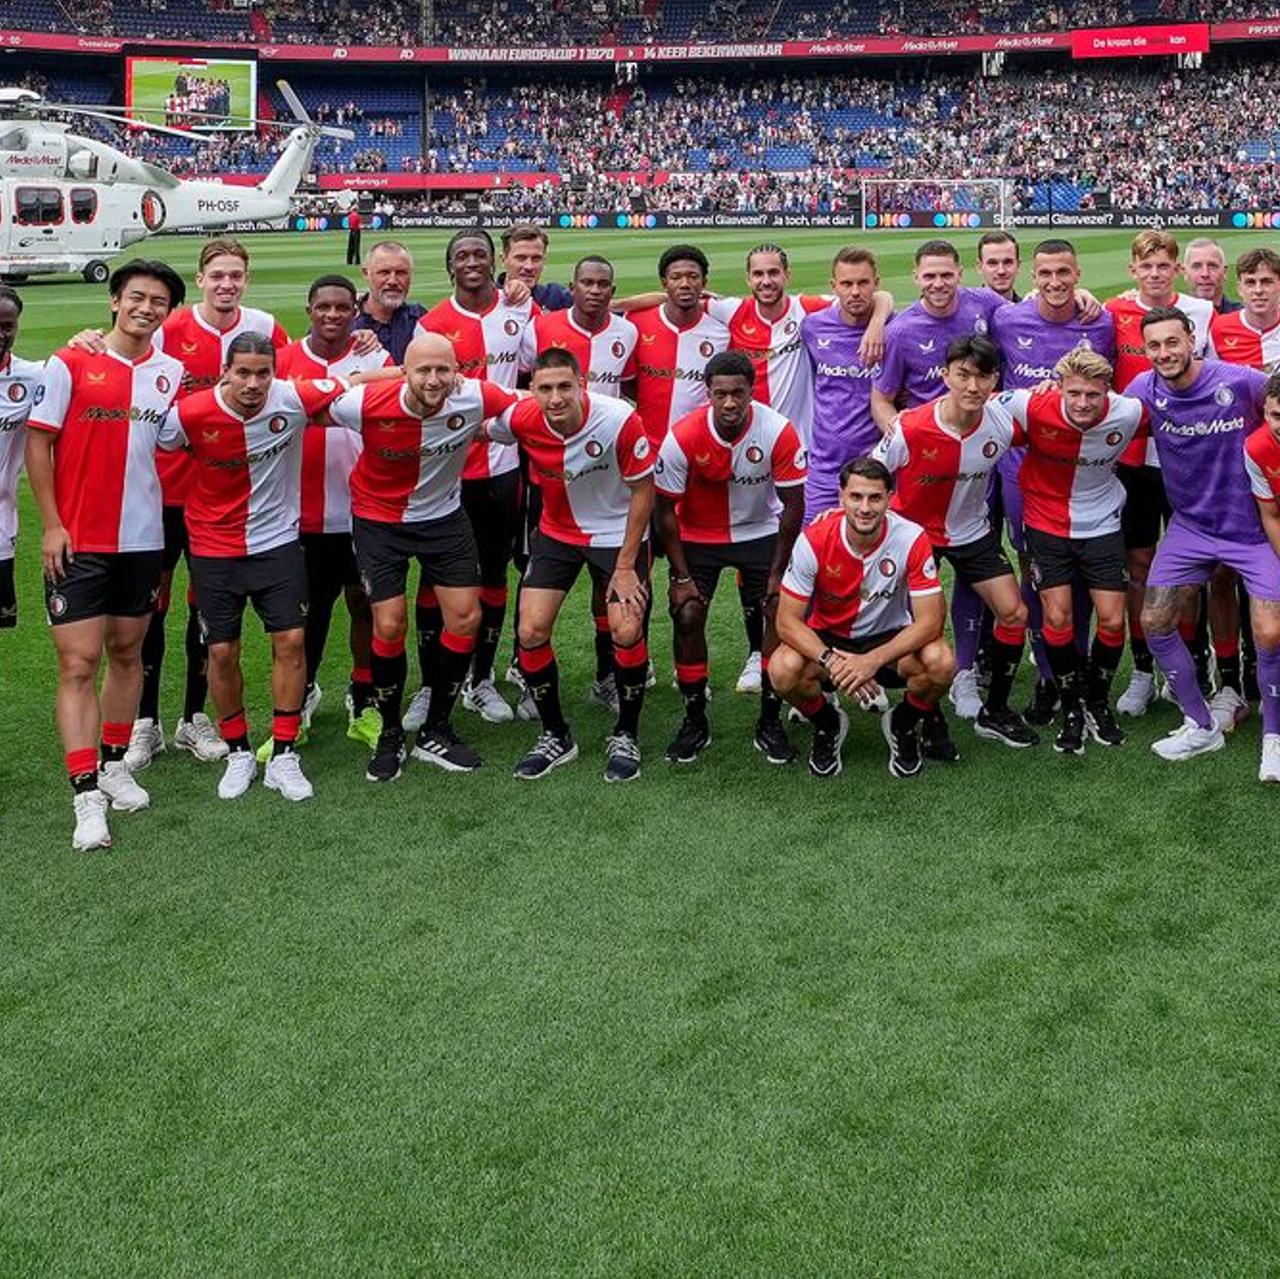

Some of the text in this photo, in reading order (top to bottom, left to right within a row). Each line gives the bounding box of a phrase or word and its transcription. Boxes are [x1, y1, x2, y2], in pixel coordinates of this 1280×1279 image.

[332, 47, 348, 59] AD
[399, 48, 415, 60] AD
[447, 48, 508, 61] WINNAAR
[509, 48, 577, 60] EUROPACUP
[586, 48, 615, 60] 1970
[658, 46, 687, 58] KEER
[688, 44, 783, 58] BEKERWINNAAR
[667, 214, 713, 228] Supersnel
[772, 214, 780, 226] Ja
[811, 214, 829, 226] niet
[1051, 213, 1113, 226] Glasvezel?
[1120, 213, 1132, 226] Ja
[1133, 213, 1165, 228] toch,
[1168, 213, 1190, 226] niet
[1193, 213, 1219, 226] dan!
[1206, 417, 1243, 435] Markt
